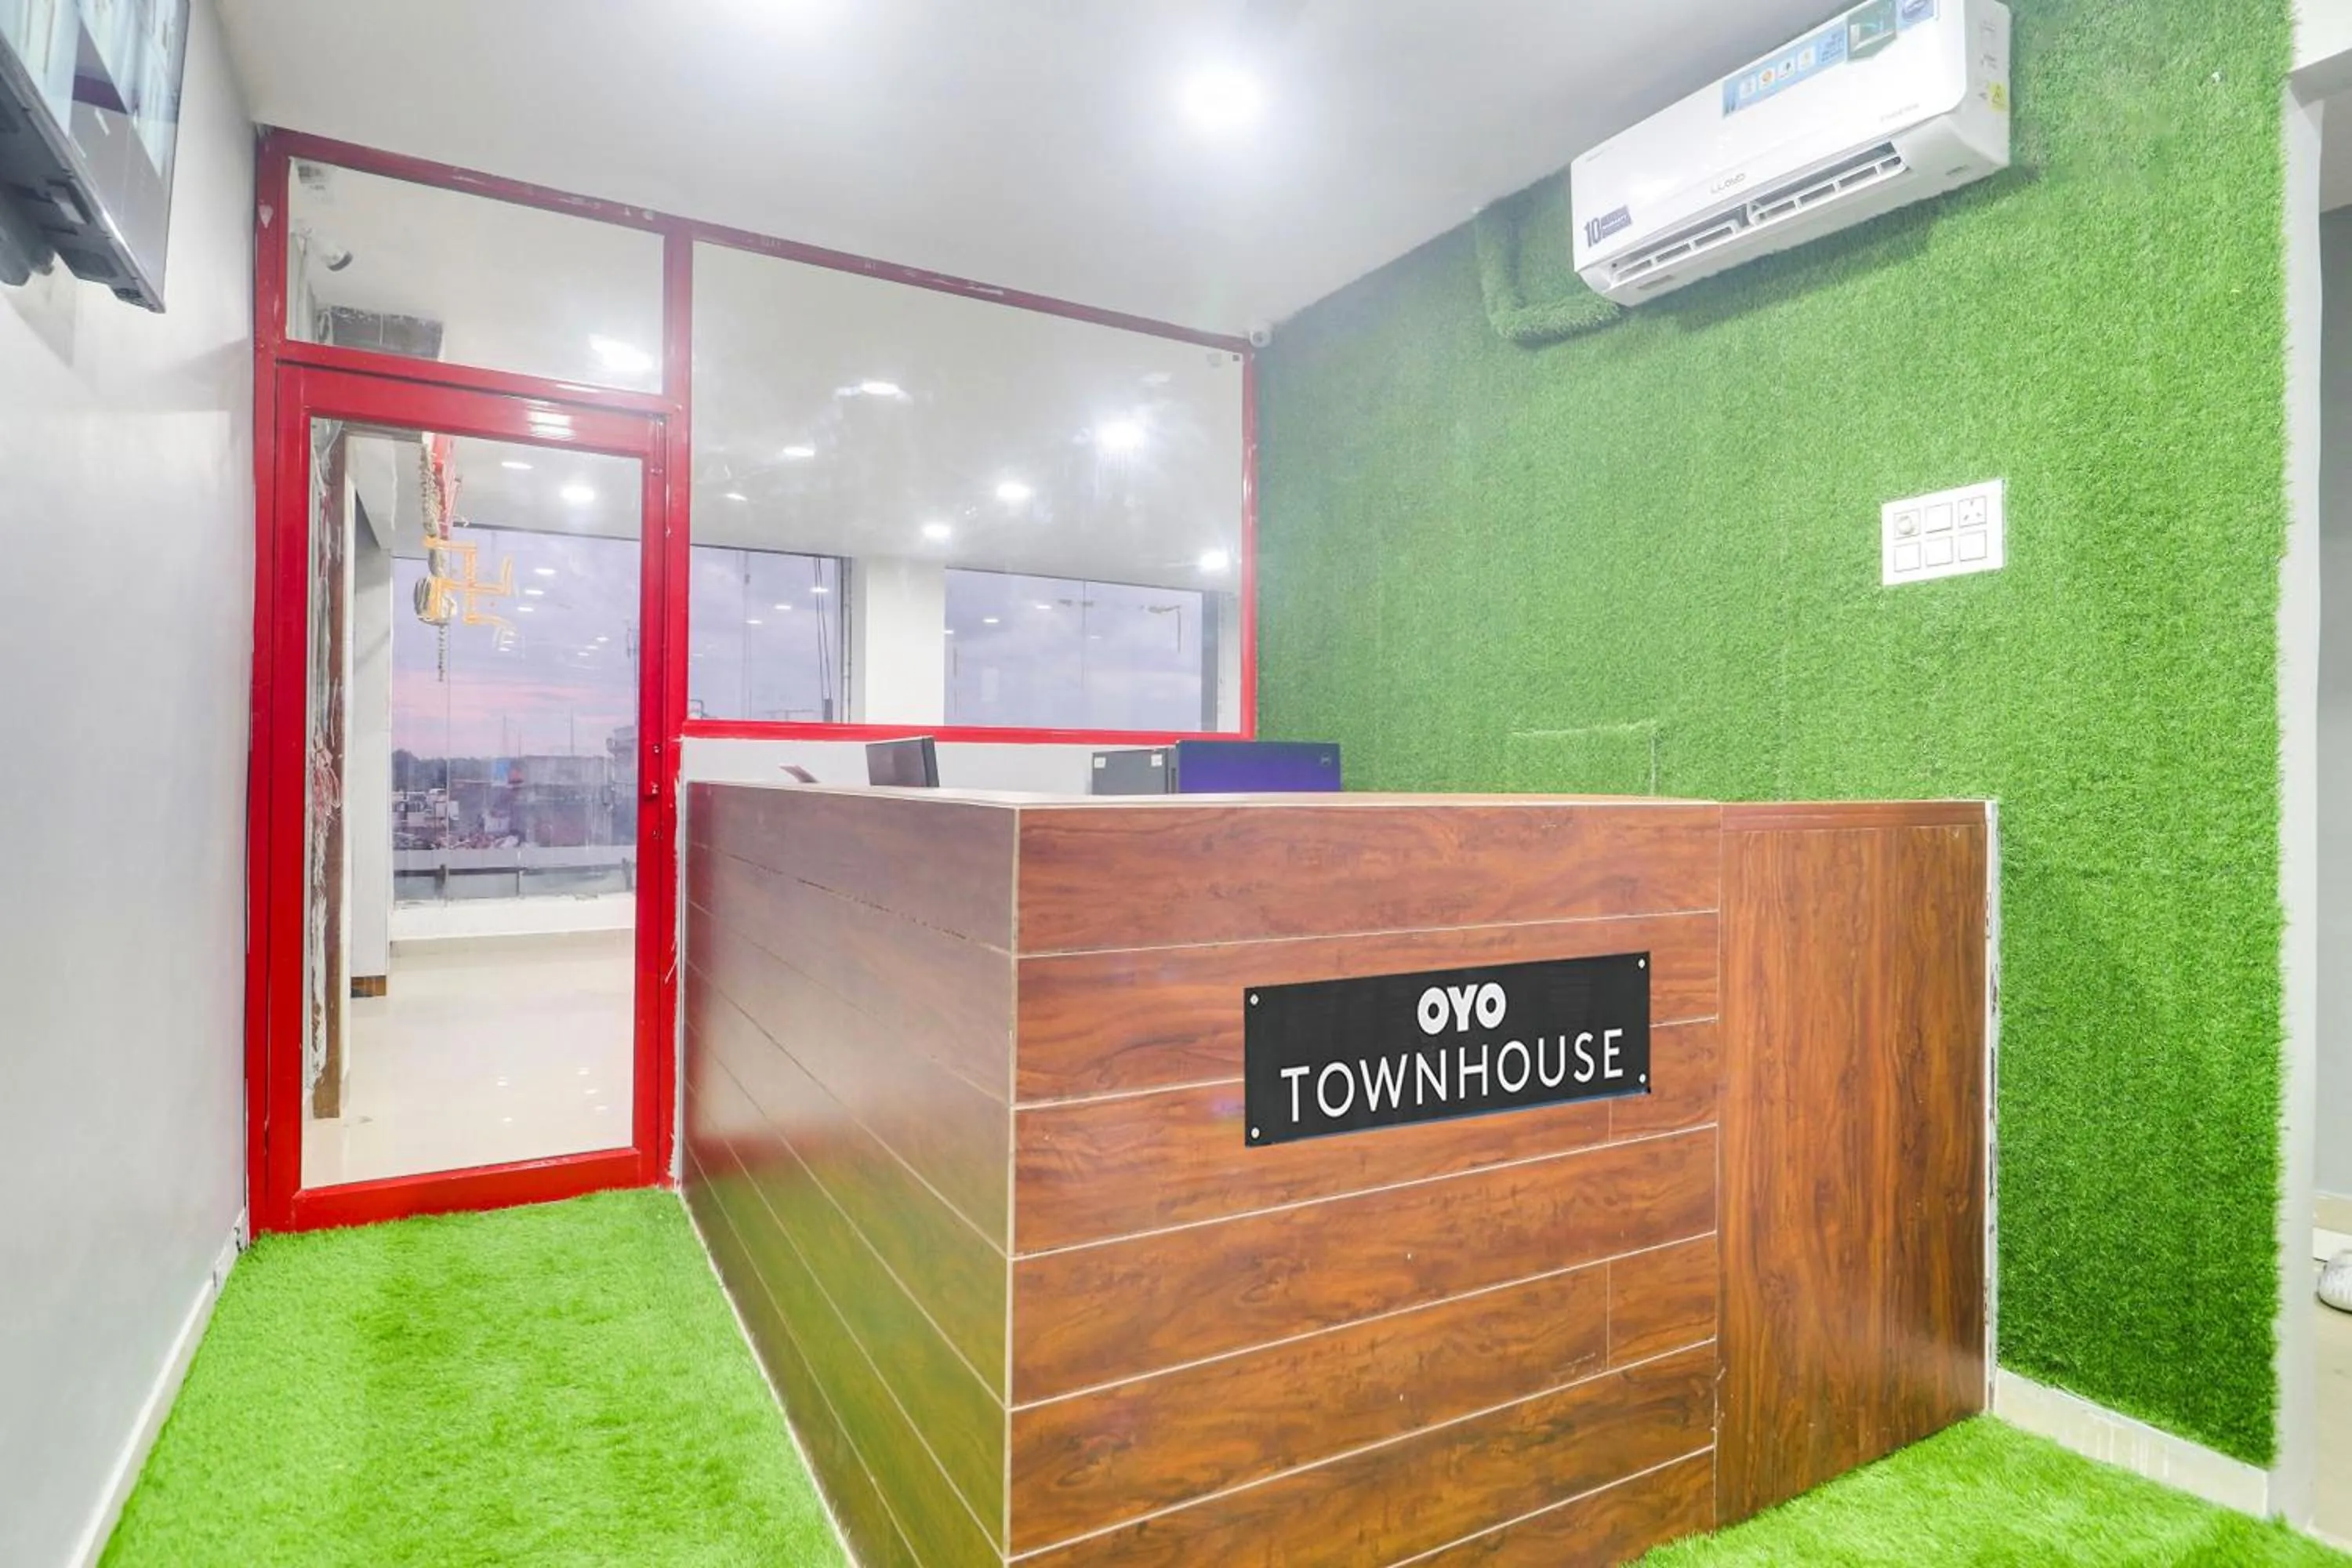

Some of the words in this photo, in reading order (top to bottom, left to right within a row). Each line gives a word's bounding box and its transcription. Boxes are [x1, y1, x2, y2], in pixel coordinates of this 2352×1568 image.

[1584, 217, 1601, 249] 10
[1417, 982, 1507, 1035] OYO
[1280, 1029, 1624, 1123] TOWNHOUSE
